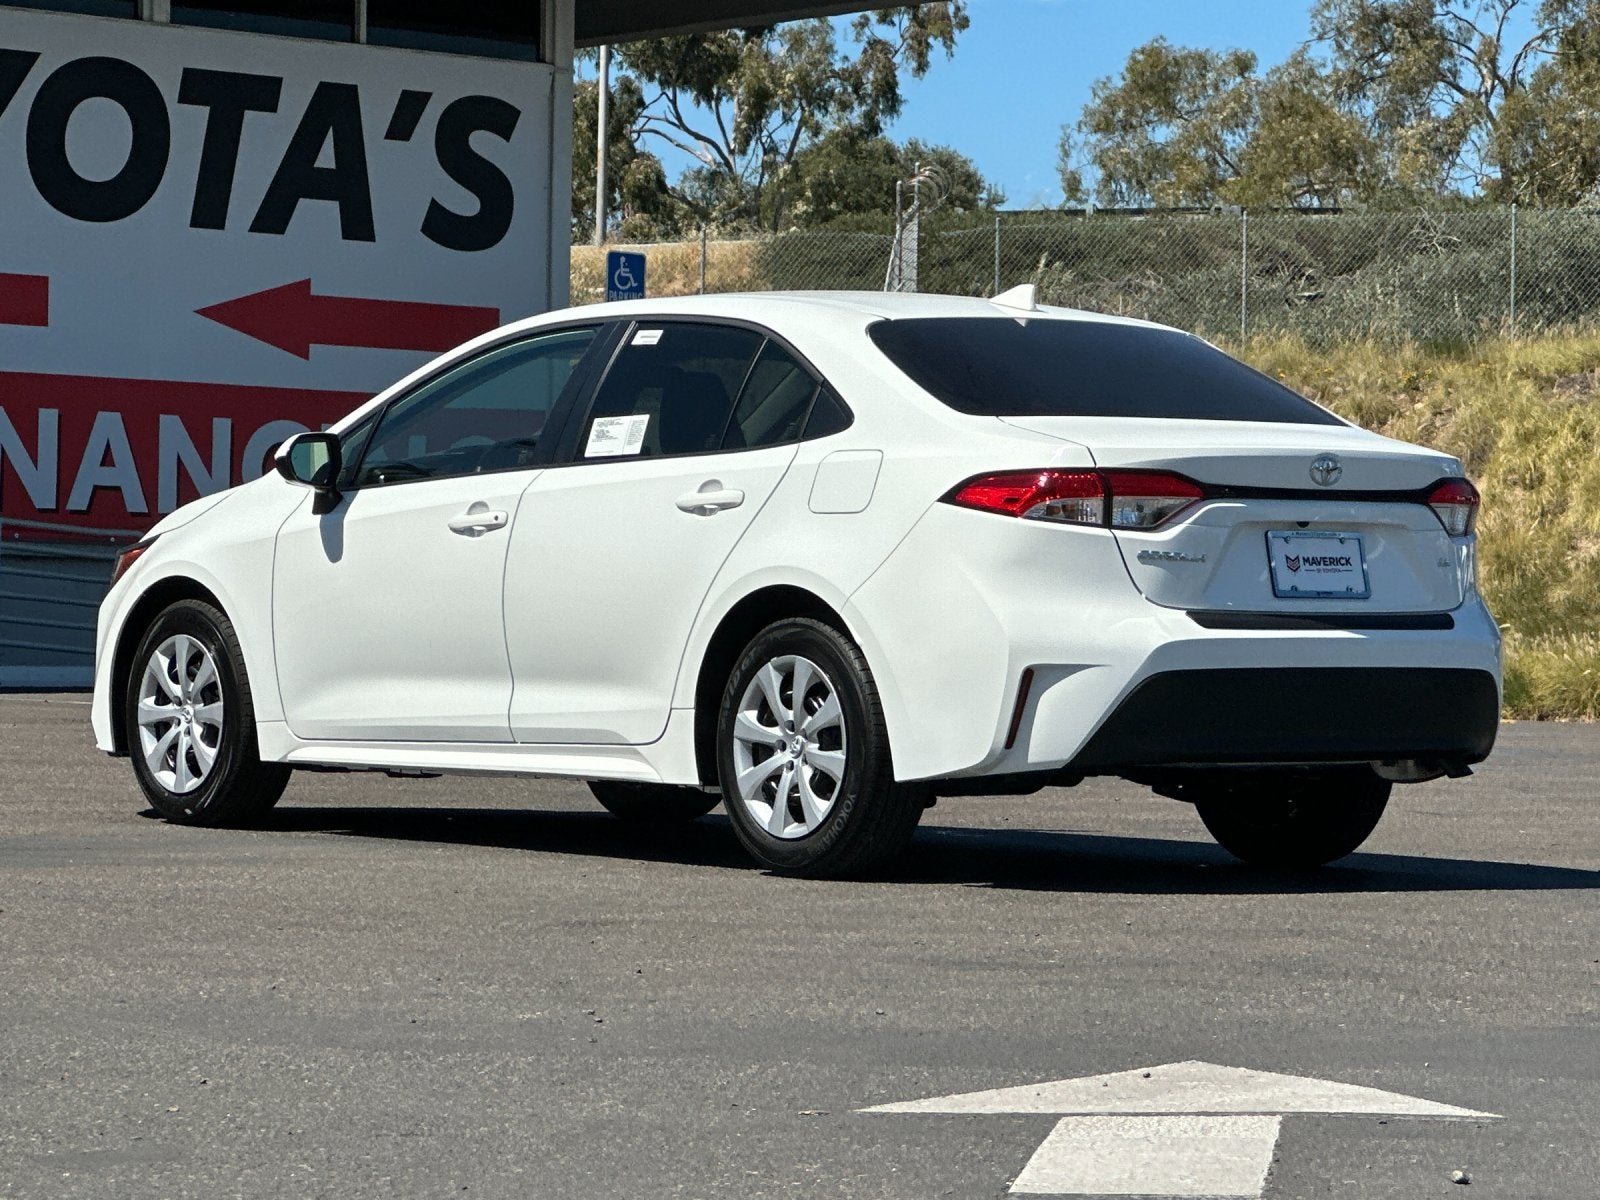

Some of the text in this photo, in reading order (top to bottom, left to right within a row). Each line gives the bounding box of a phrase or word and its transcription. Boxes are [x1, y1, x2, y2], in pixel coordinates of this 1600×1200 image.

[0, 49, 521, 252] OTA'S
[1302, 556, 1353, 567] MAVERICK
[814, 792, 857, 855] YOKOHA
